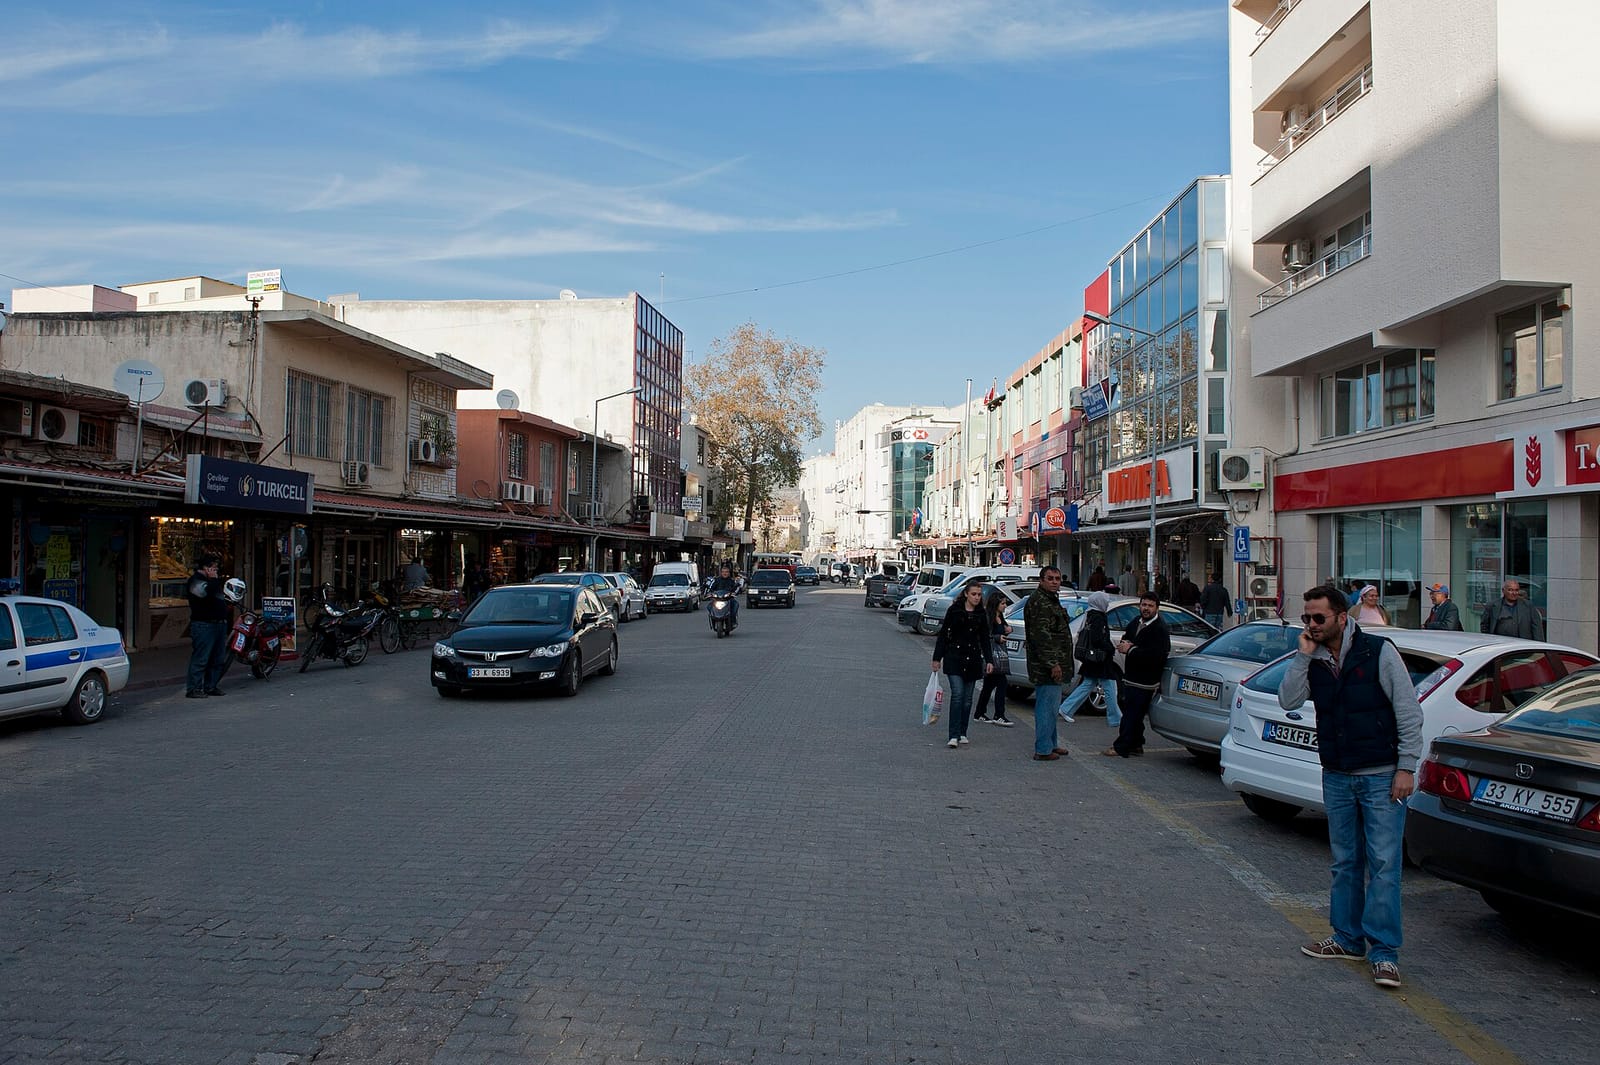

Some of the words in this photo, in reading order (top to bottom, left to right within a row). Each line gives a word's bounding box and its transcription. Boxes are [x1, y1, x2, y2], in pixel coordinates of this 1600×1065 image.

[256, 480, 305, 501] TURKCELL
[1182, 679, 1190, 690] 34
[1202, 684, 1219, 697] 3441
[1276, 726, 1290, 740] 33
[1289, 728, 1311, 745] KFB
[1486, 783, 1506, 799] 33
[1513, 788, 1535, 805] KY
[1541, 794, 1575, 814] 555
